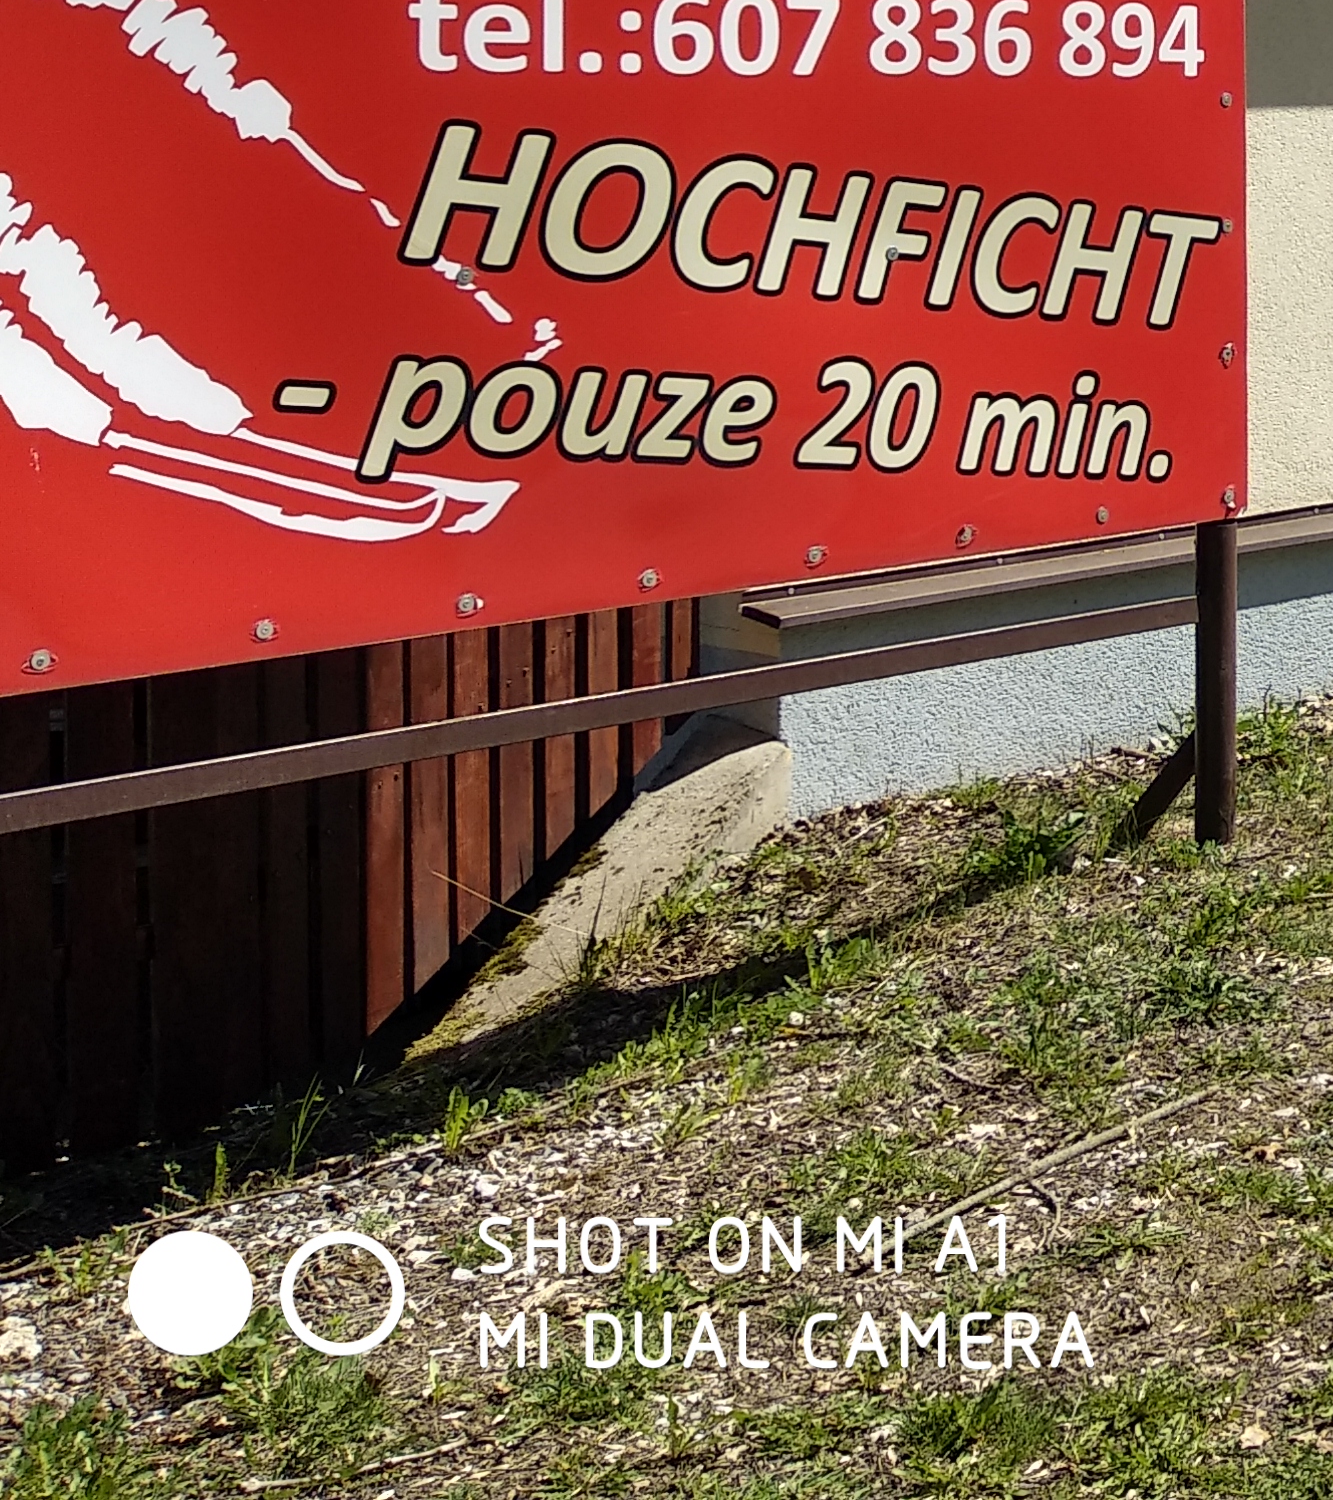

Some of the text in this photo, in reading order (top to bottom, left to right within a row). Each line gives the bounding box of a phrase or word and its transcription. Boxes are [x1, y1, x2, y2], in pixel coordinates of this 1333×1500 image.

[1058, 0, 1206, 79] 894
[397, 119, 1222, 331] HOCHFICHT
[357, 356, 777, 480] pouze
[793, 356, 941, 473] 20
[956, 370, 1173, 483] min.
